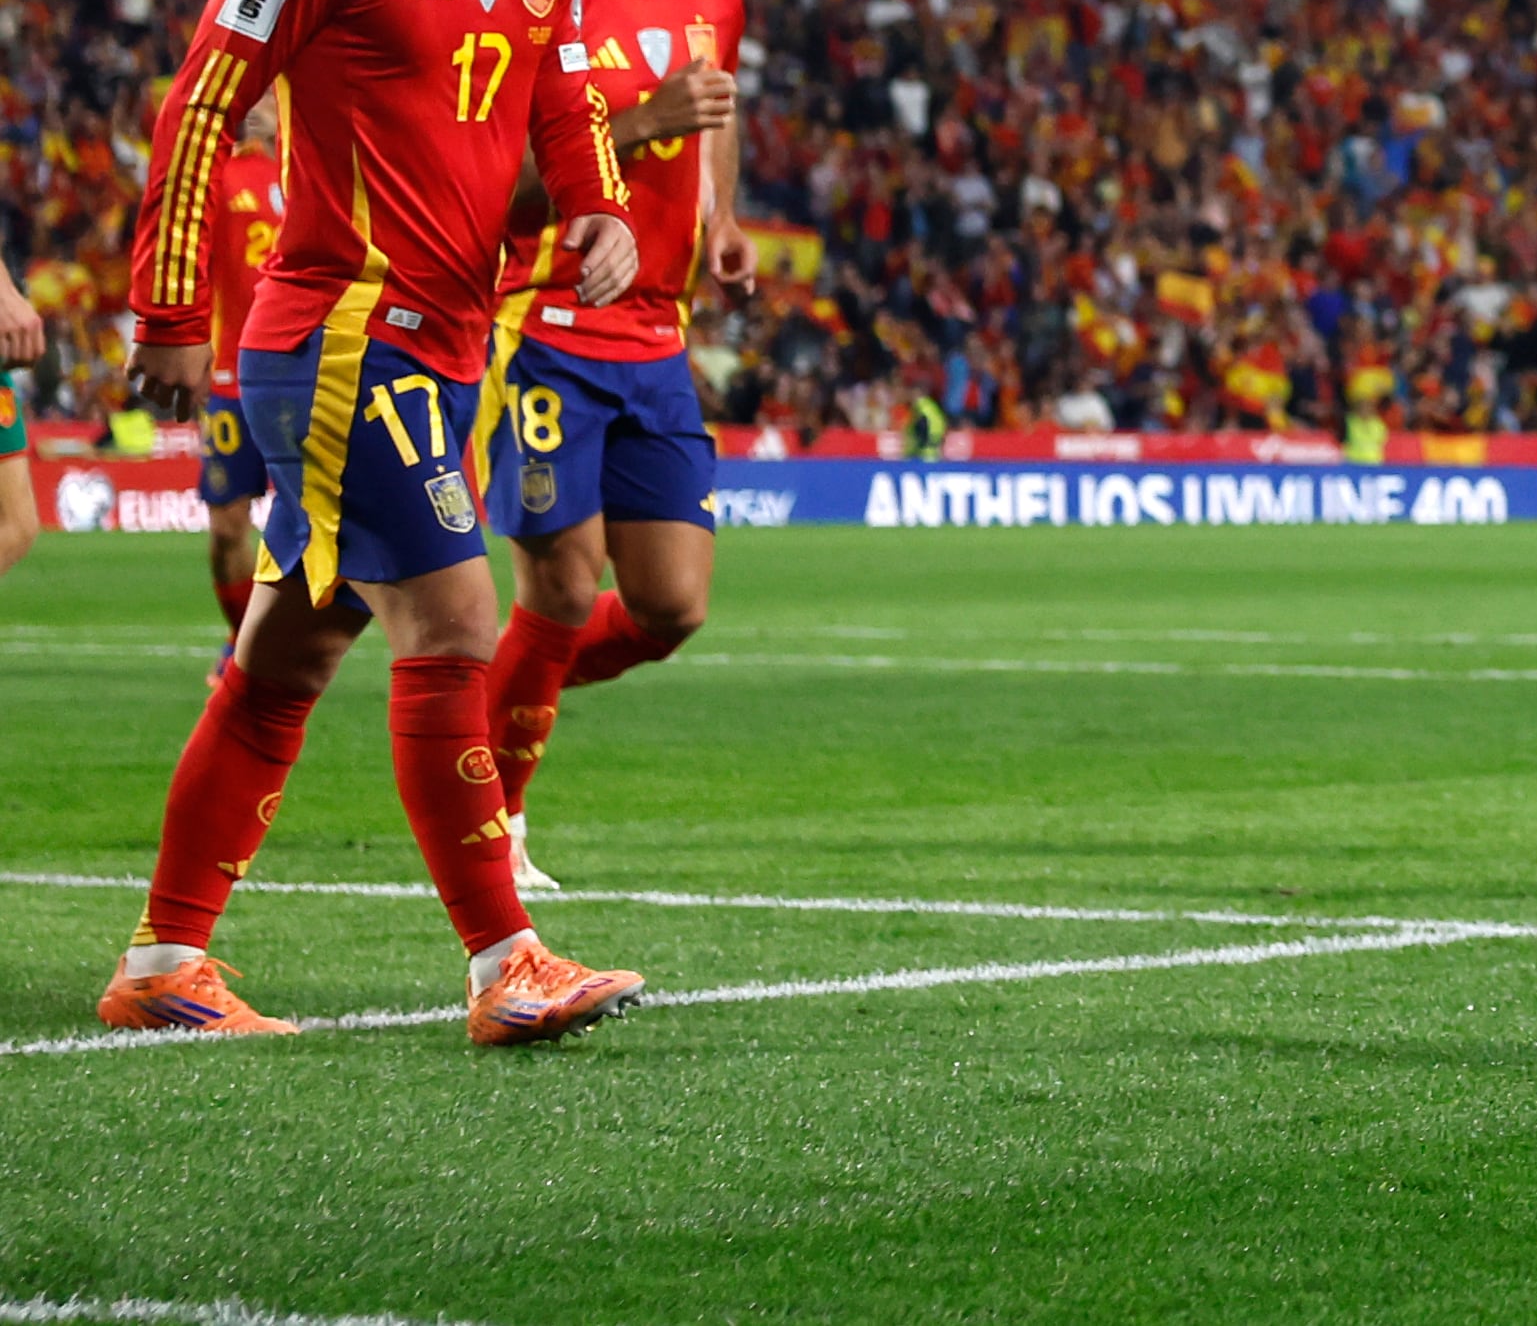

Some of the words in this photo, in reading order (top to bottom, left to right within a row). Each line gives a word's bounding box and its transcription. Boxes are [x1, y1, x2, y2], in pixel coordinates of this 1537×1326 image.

[452, 32, 512, 122] 17
[245, 220, 280, 268] 2
[363, 373, 446, 468] 17
